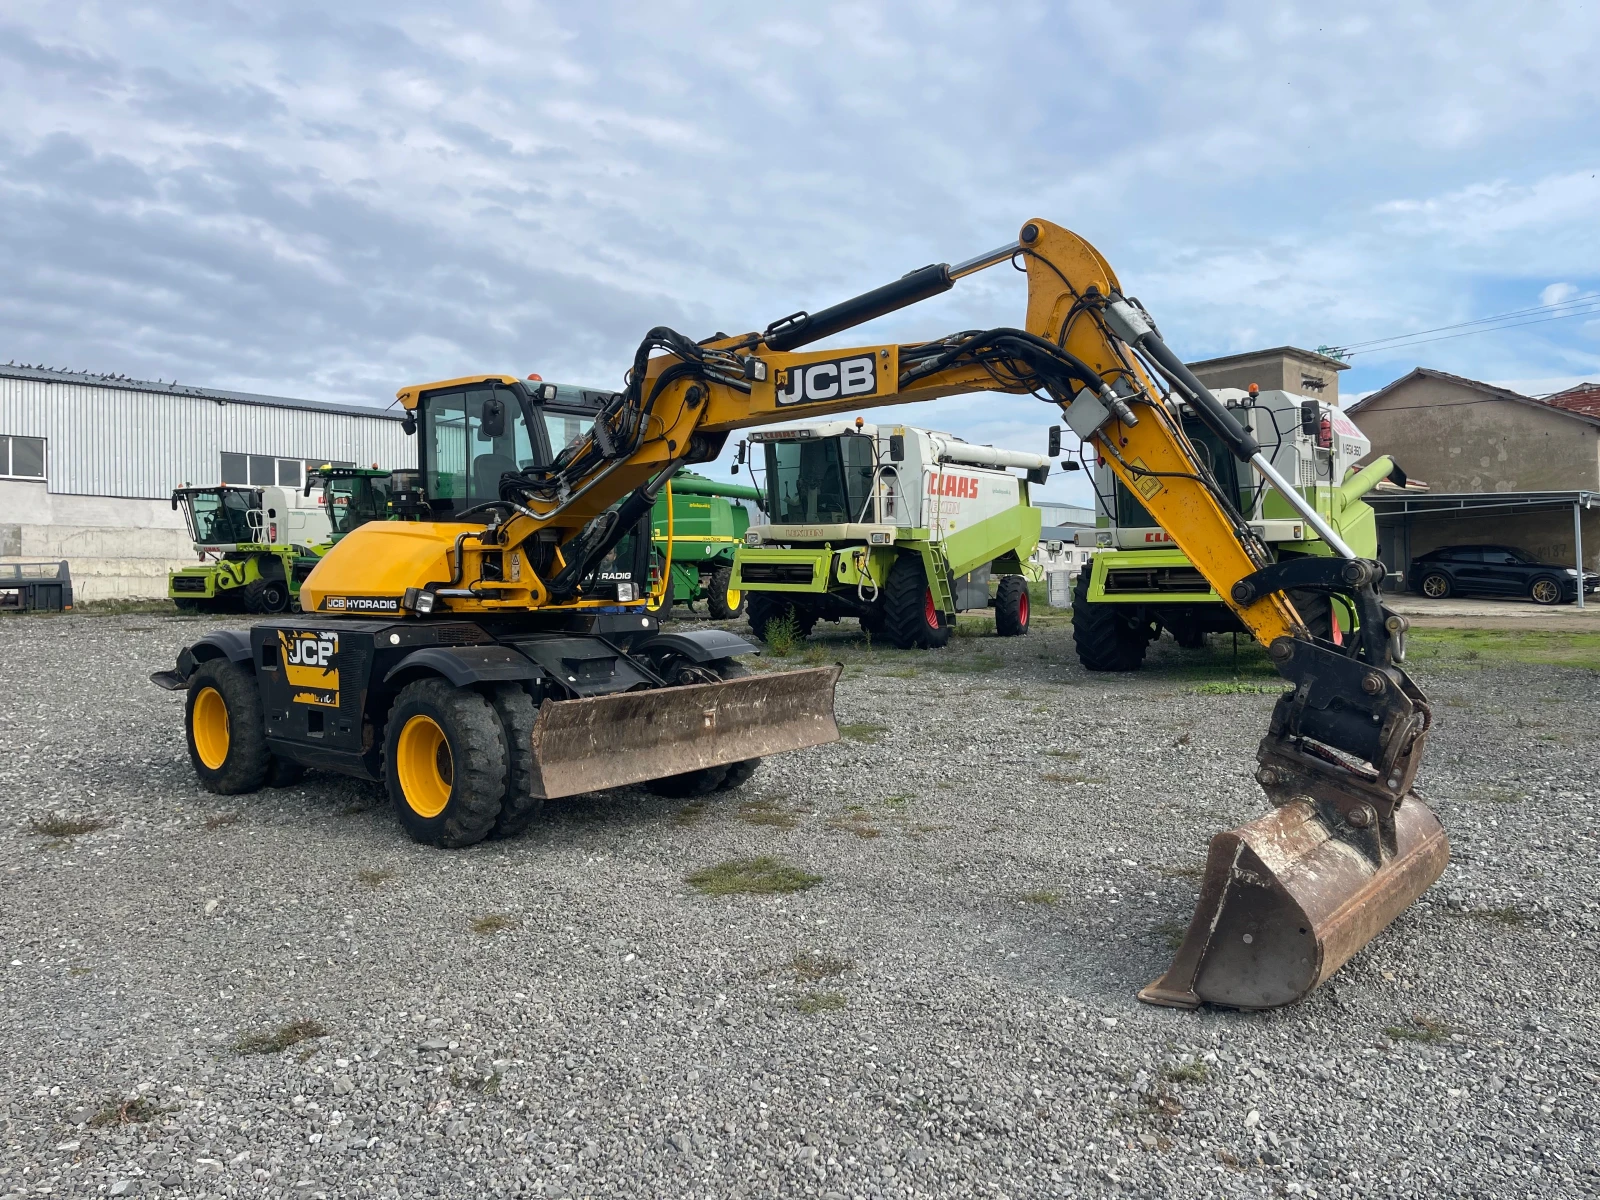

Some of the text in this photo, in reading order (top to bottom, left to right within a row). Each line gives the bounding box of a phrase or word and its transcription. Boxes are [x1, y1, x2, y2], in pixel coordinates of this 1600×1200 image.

[778, 358, 875, 404] JCB
[764, 431, 797, 439] CLAAS
[927, 473, 979, 499] CLAAS
[786, 529, 824, 537] LEXION
[585, 572, 632, 580] YRADIG
[328, 600, 397, 609] JCB HYDRADIG
[288, 639, 334, 666] JCB
